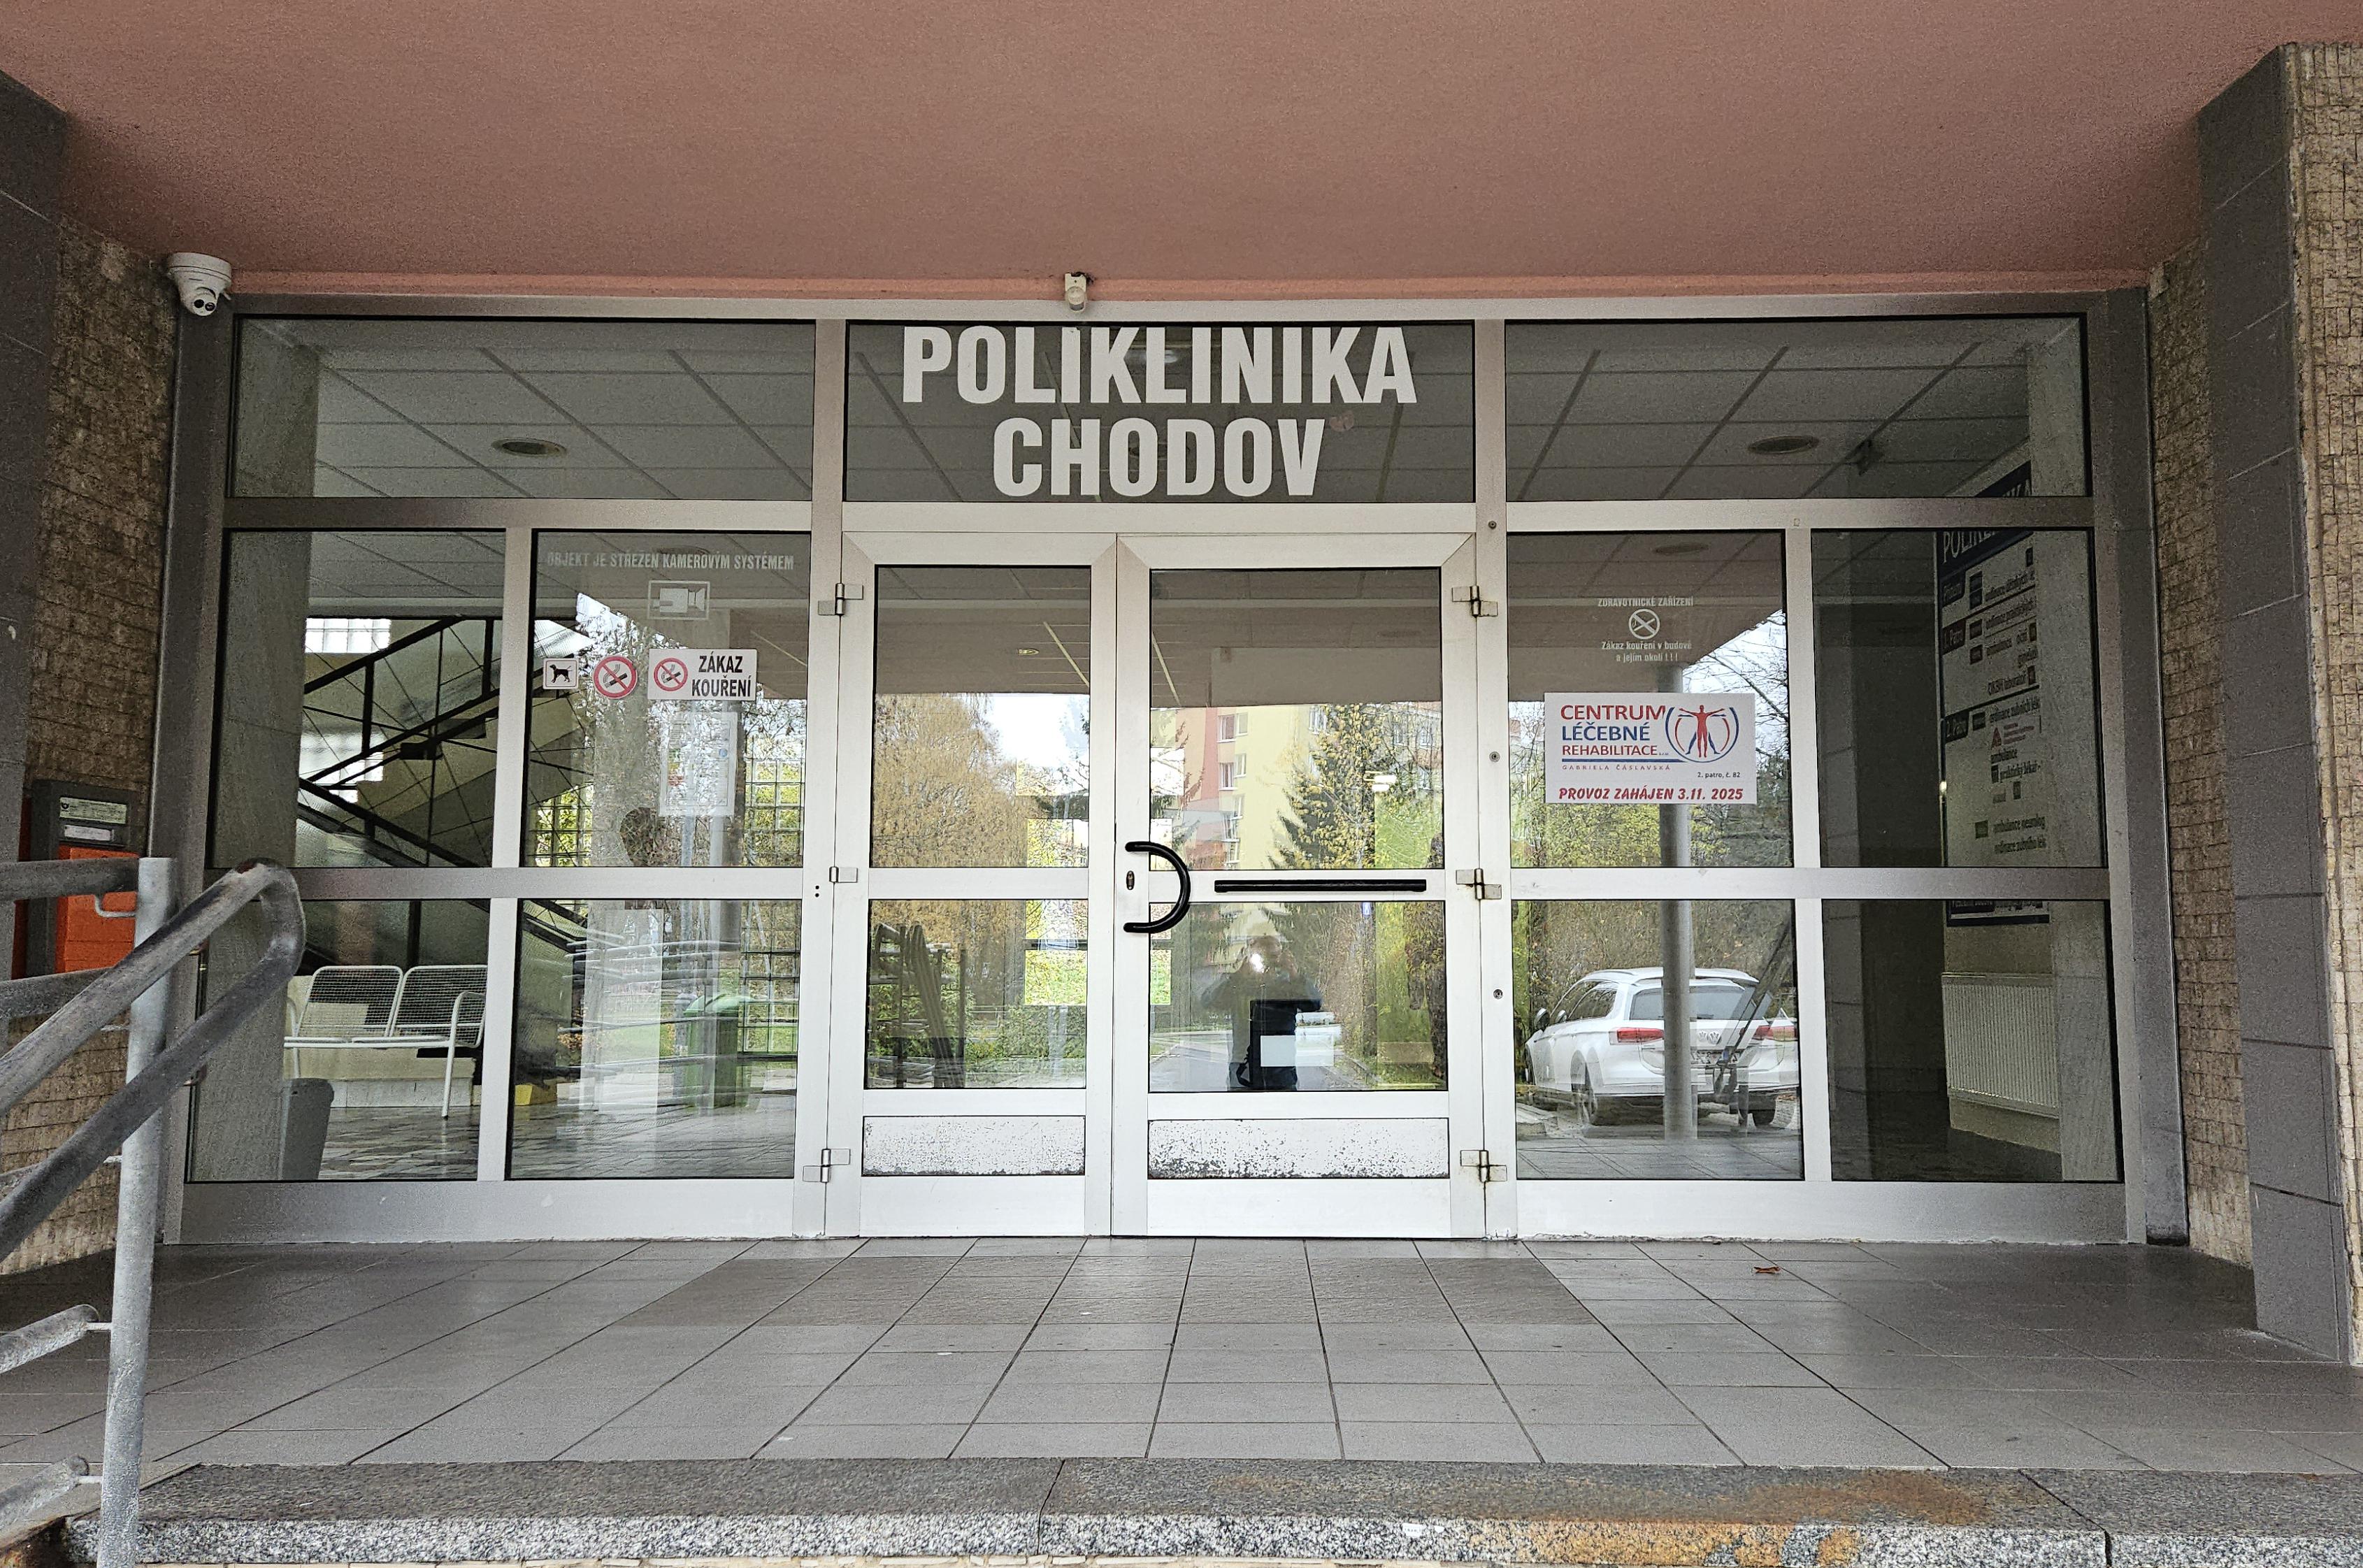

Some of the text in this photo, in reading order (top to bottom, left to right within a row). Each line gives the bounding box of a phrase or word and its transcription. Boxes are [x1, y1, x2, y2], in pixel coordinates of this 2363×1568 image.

[903, 326, 1418, 403] POLIKLINIKA
[993, 417, 1326, 496] CHODOV
[547, 552, 589, 566] OBJEKT
[593, 552, 608, 567] JE
[663, 549, 730, 570] KAMEROVÝM
[734, 551, 794, 570] SYSTÉMEM
[1597, 595, 1693, 607] ZDRAVOTNICKÉ ZAŘÍZENÍ
[1601, 640, 1624, 650] Zákaz
[1626, 640, 1655, 650] kouření
[698, 652, 743, 673] ZÁKAZ
[691, 674, 752, 698] KOUŘENÍ
[1560, 705, 1665, 720] CENTRUM
[1562, 721, 1651, 741] LÉČEBNÉ
[1562, 745, 1658, 756] REHABILITACE
[1559, 784, 1744, 800] PROVOZ ZAHÁJEN 3.11. 2025
